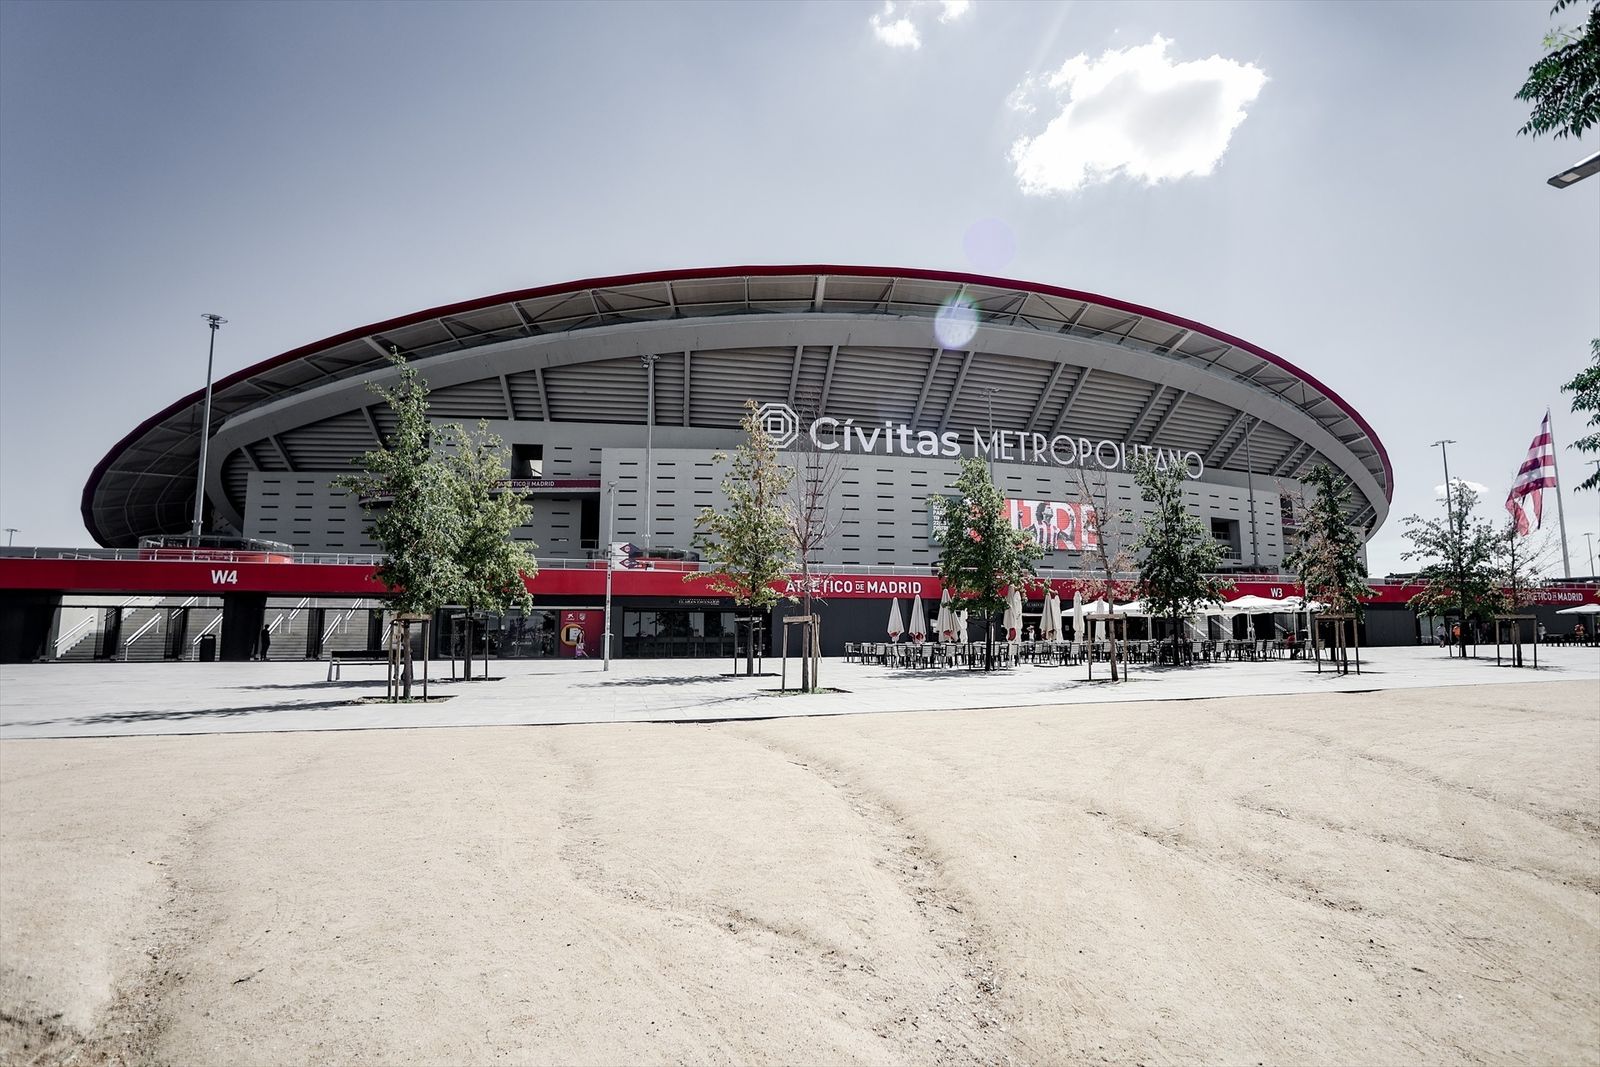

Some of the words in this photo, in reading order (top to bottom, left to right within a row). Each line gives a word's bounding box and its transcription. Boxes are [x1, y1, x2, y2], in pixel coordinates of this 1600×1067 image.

[809, 416, 961, 457] Cívitas
[211, 569, 238, 585] W4
[785, 577, 853, 593] ATÉTICO
[855, 581, 865, 593] DE
[867, 581, 922, 594] MADRID
[1270, 587, 1283, 598] W3
[1557, 592, 1583, 601] MADRID
